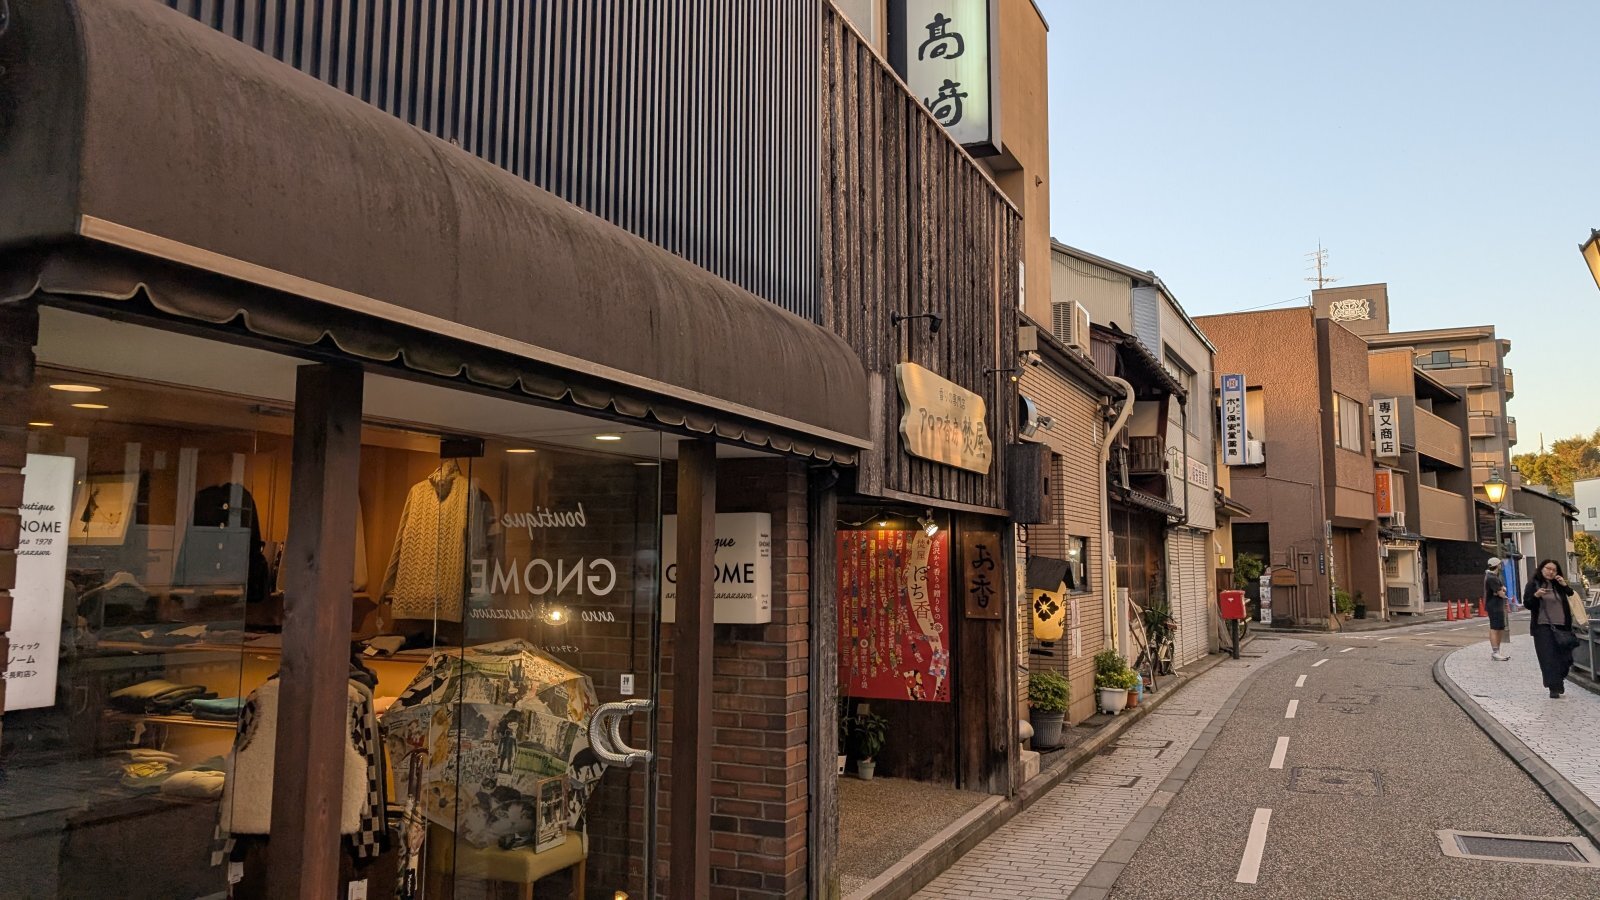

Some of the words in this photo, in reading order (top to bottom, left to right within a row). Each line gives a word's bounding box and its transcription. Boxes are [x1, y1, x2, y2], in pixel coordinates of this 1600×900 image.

[20, 501, 55, 516] outique
[20, 520, 61, 533] NOME
[35, 538, 53, 546] 1978
[970, 544, 996, 608] お香
[714, 591, 753, 599] anazawa
[9, 642, 40, 651] ティック
